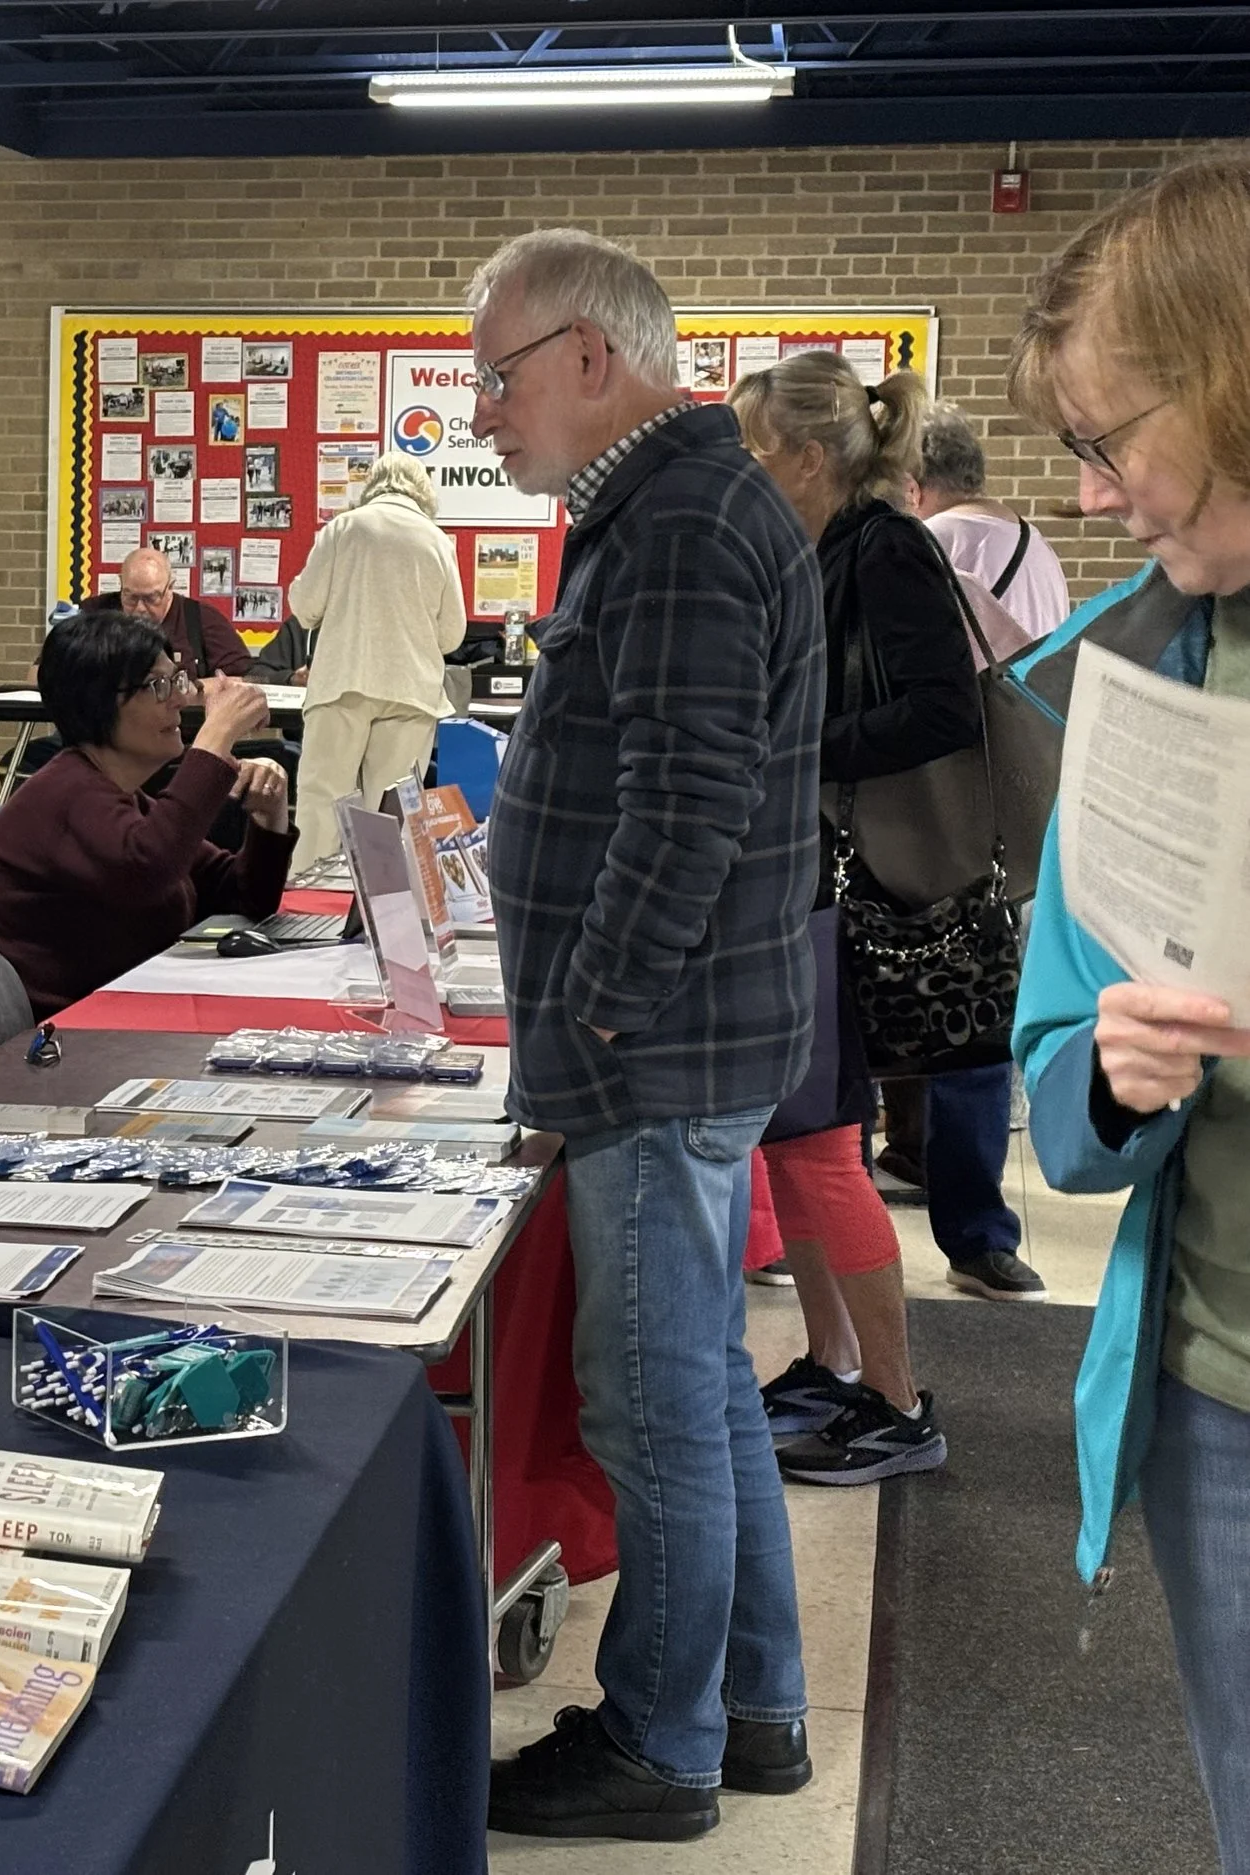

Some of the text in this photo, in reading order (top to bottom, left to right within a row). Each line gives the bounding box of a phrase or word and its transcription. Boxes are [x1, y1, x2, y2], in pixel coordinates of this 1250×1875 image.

[449, 418, 471, 431] Ch
[441, 466, 512, 487] INVOL
[0, 1461, 59, 1505] SLEEP
